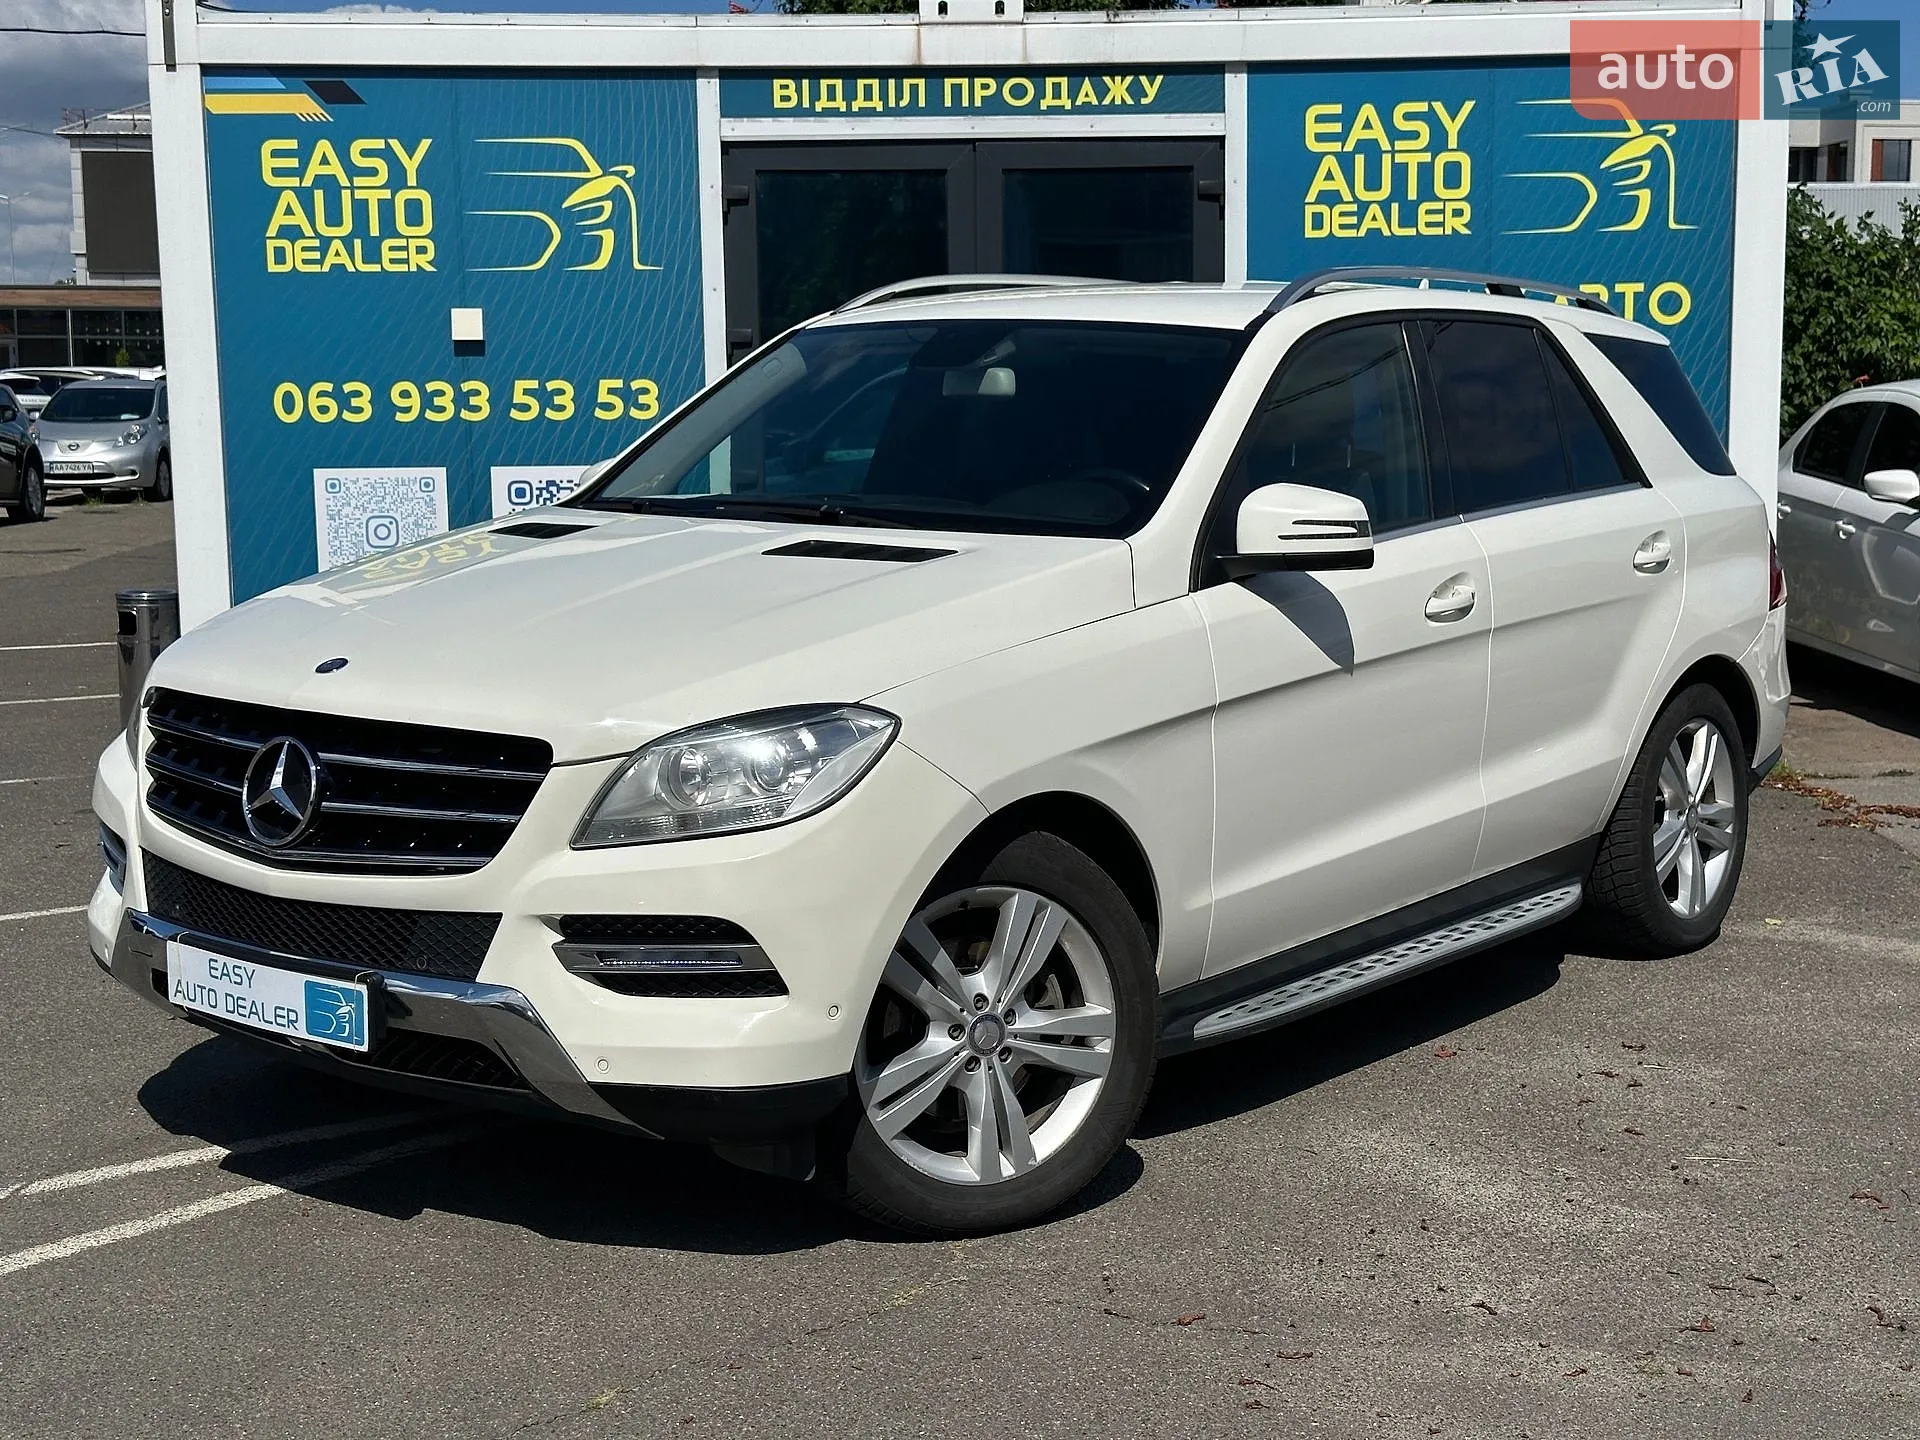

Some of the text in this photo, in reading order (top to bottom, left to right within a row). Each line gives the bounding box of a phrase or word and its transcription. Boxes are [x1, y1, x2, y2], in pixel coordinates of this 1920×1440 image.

[772, 74, 1164, 112] ВІДДІЛ ПРОДАЖУ
[1304, 100, 1475, 153] EASY
[260, 138, 432, 188] EASY
[1305, 150, 1472, 203] AUTO
[265, 188, 434, 238] AUTO
[1304, 200, 1472, 239] DEALER
[265, 237, 437, 273] DEALER
[1555, 281, 1692, 326] ТО
[272, 377, 660, 424] 063 933 53 53
[207, 958, 256, 989] EASY
[173, 978, 299, 1031] AUTO DEALER
